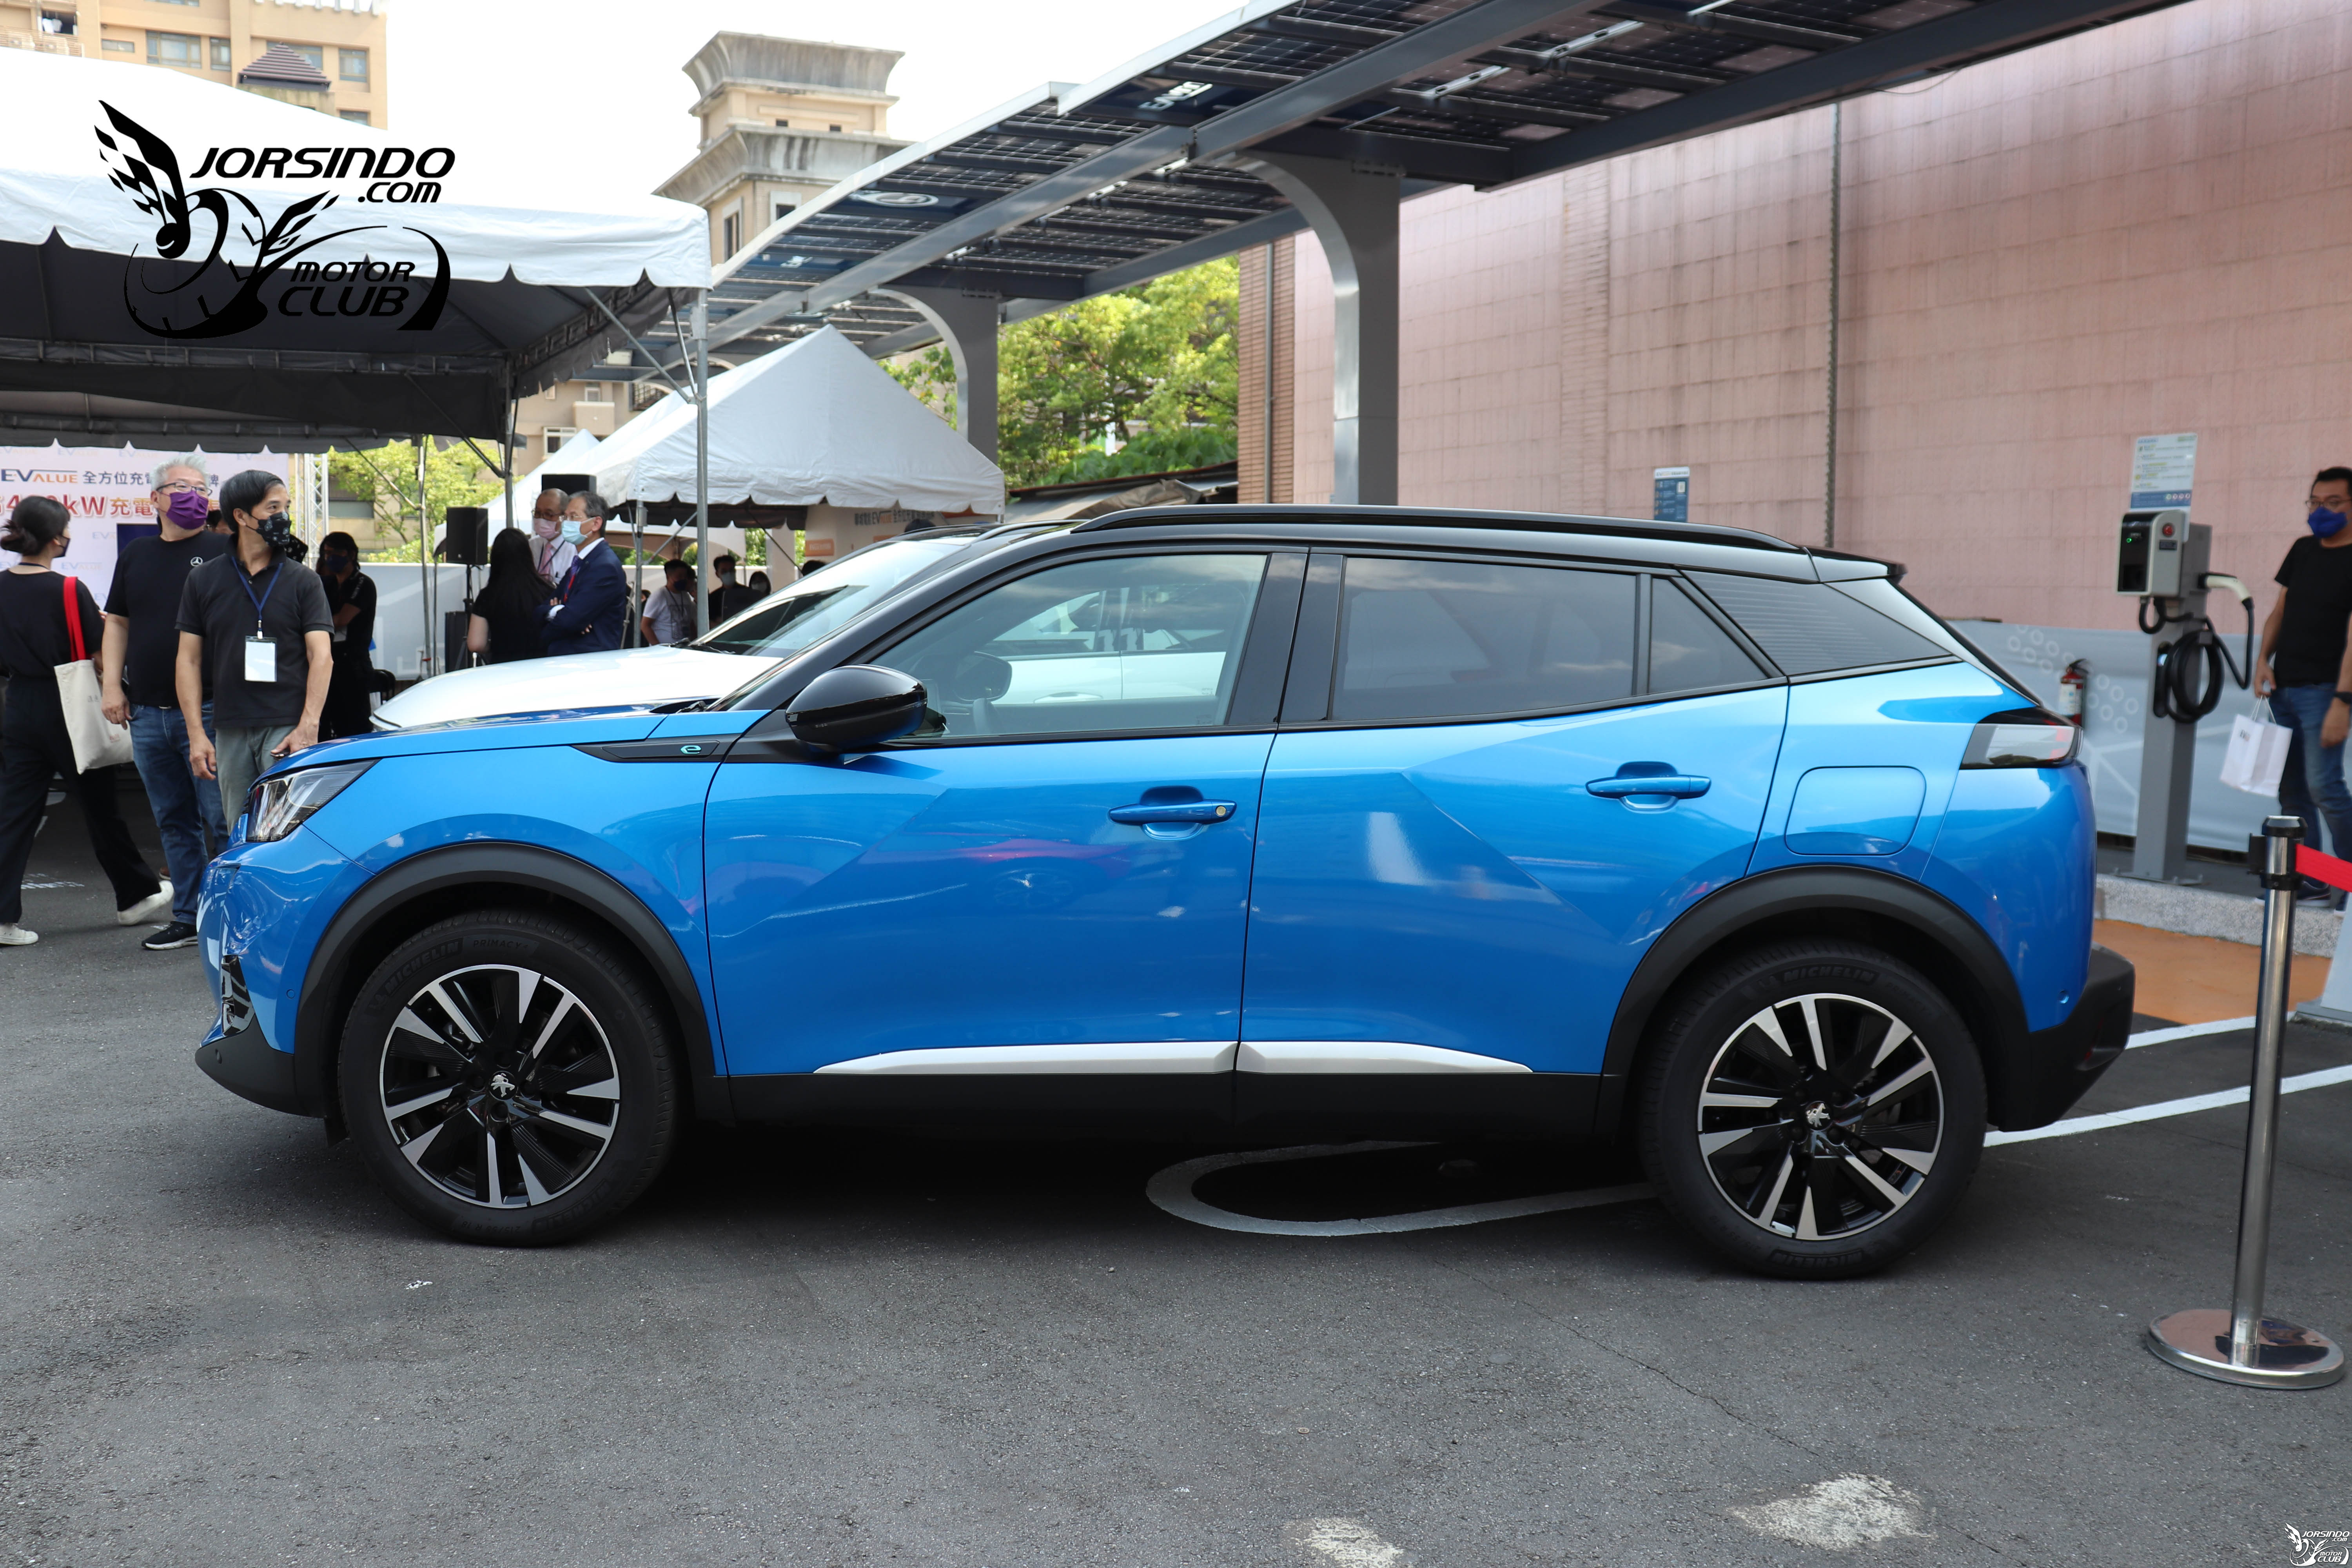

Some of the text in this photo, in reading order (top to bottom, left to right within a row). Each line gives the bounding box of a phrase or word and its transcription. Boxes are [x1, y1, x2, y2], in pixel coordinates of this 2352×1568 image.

[1, 468, 78, 483] EVALUE
[383, 941, 459, 994] MICHELIN
[473, 939, 521, 949] PRIMACY
[1784, 965, 1875, 983] MICHELIN
